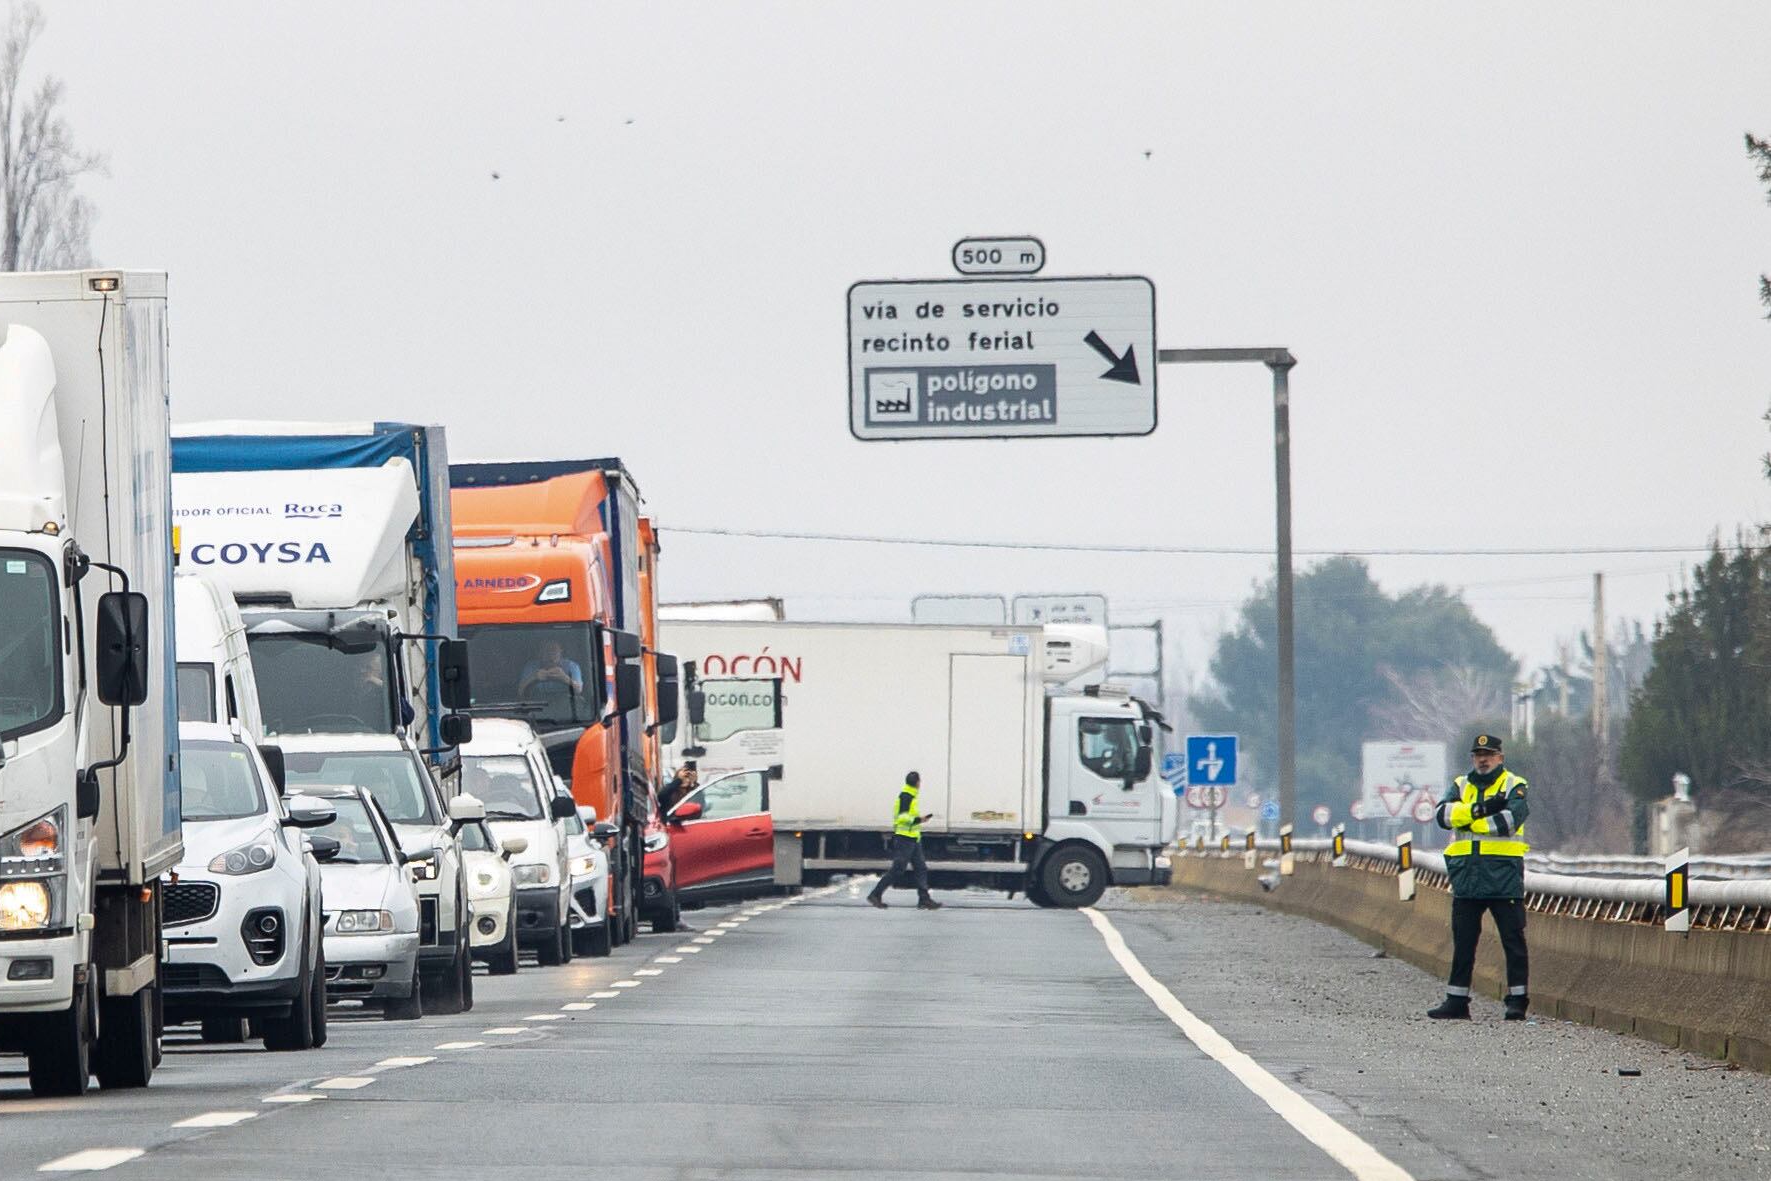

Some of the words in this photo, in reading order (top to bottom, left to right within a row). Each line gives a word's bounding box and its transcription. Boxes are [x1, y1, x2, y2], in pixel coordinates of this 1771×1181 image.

[962, 249, 1002, 265] 500
[1020, 251, 1036, 264] m
[916, 301, 945, 319] de
[963, 297, 1060, 318] servicio
[862, 333, 950, 352] recinto
[969, 331, 1035, 351] ferial
[928, 370, 1038, 396] polígono
[928, 400, 1053, 422] industrial
[172, 508, 211, 517] IDOR
[216, 507, 272, 516] OFICIAL
[284, 503, 342, 514] Roca
[190, 542, 332, 565] COYSA
[464, 577, 528, 588] ARNEDO
